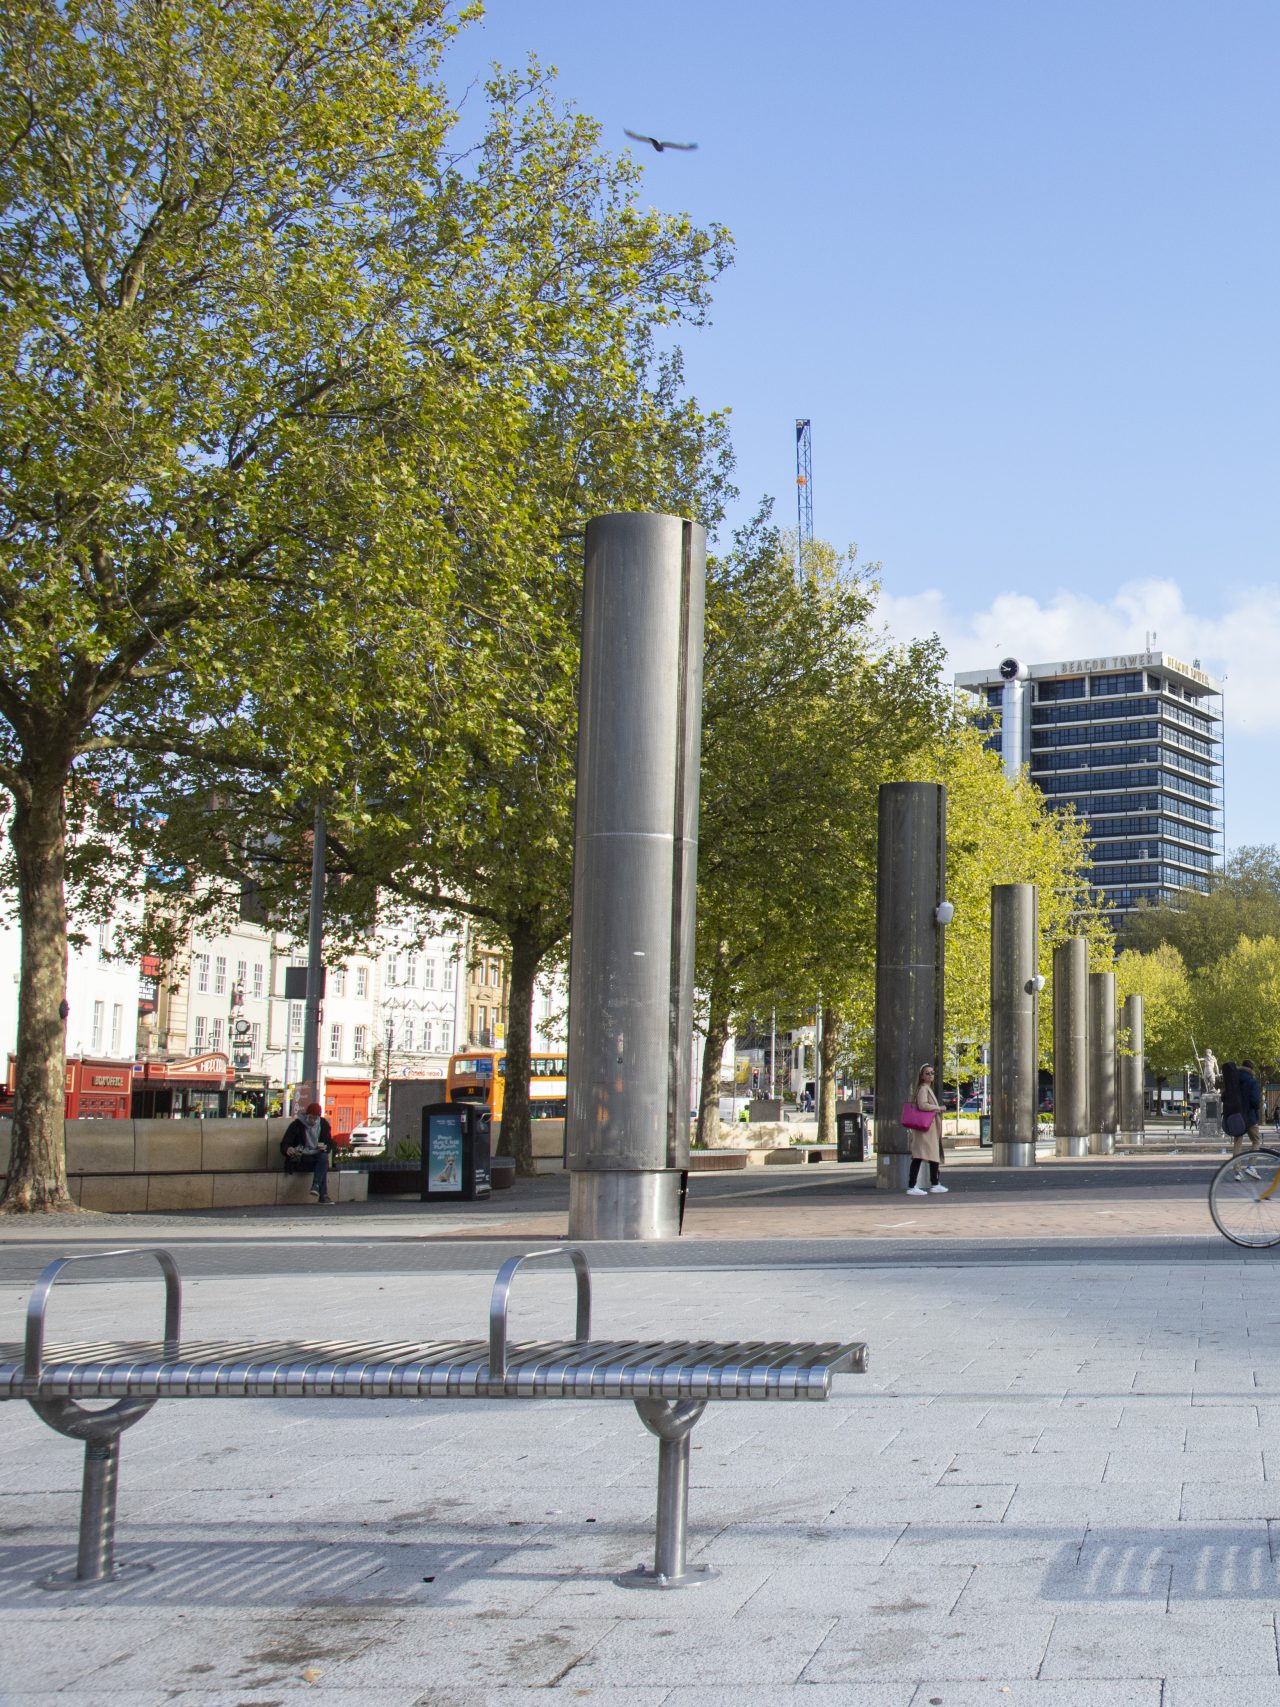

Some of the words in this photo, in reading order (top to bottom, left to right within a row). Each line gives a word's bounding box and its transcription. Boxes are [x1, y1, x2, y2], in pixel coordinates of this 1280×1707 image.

[1061, 659, 1107, 674] BEACON
[1113, 654, 1153, 668] TOWER
[1167, 656, 1189, 676] BEACON
[1190, 668, 1209, 685] TOWER
[106, 1076, 124, 1087] OFFICE
